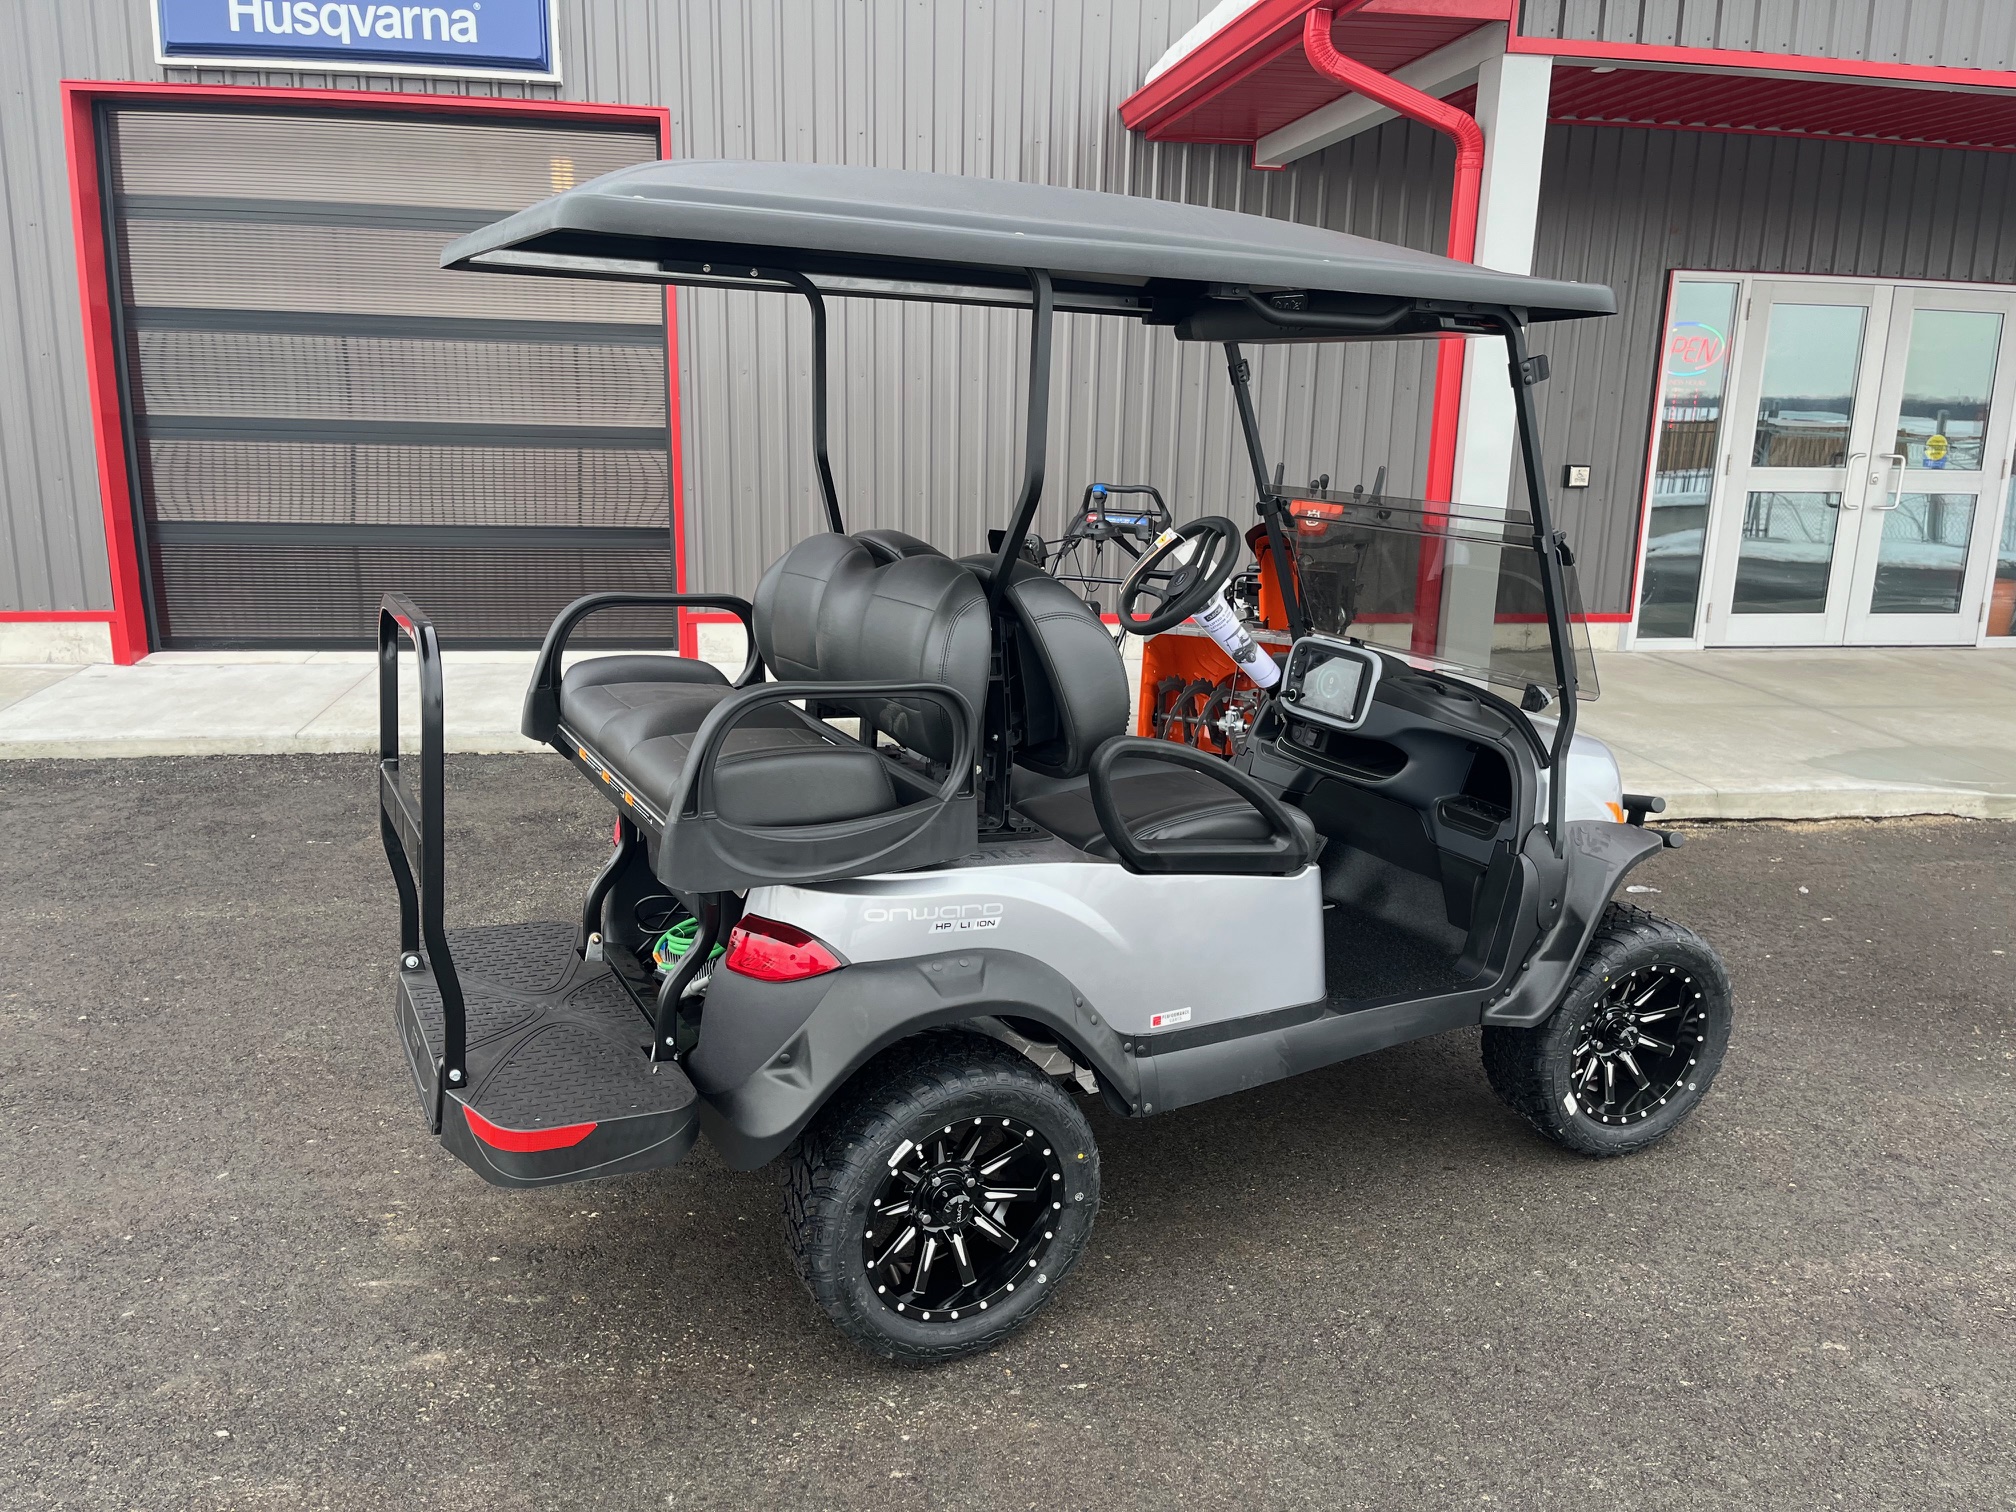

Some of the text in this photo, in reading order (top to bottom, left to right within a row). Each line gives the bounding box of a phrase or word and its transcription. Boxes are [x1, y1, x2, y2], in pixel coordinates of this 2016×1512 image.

[228, 0, 478, 44] Husqvarna
[1669, 336, 1719, 363] PEN
[935, 919, 996, 931] HP LI ION
